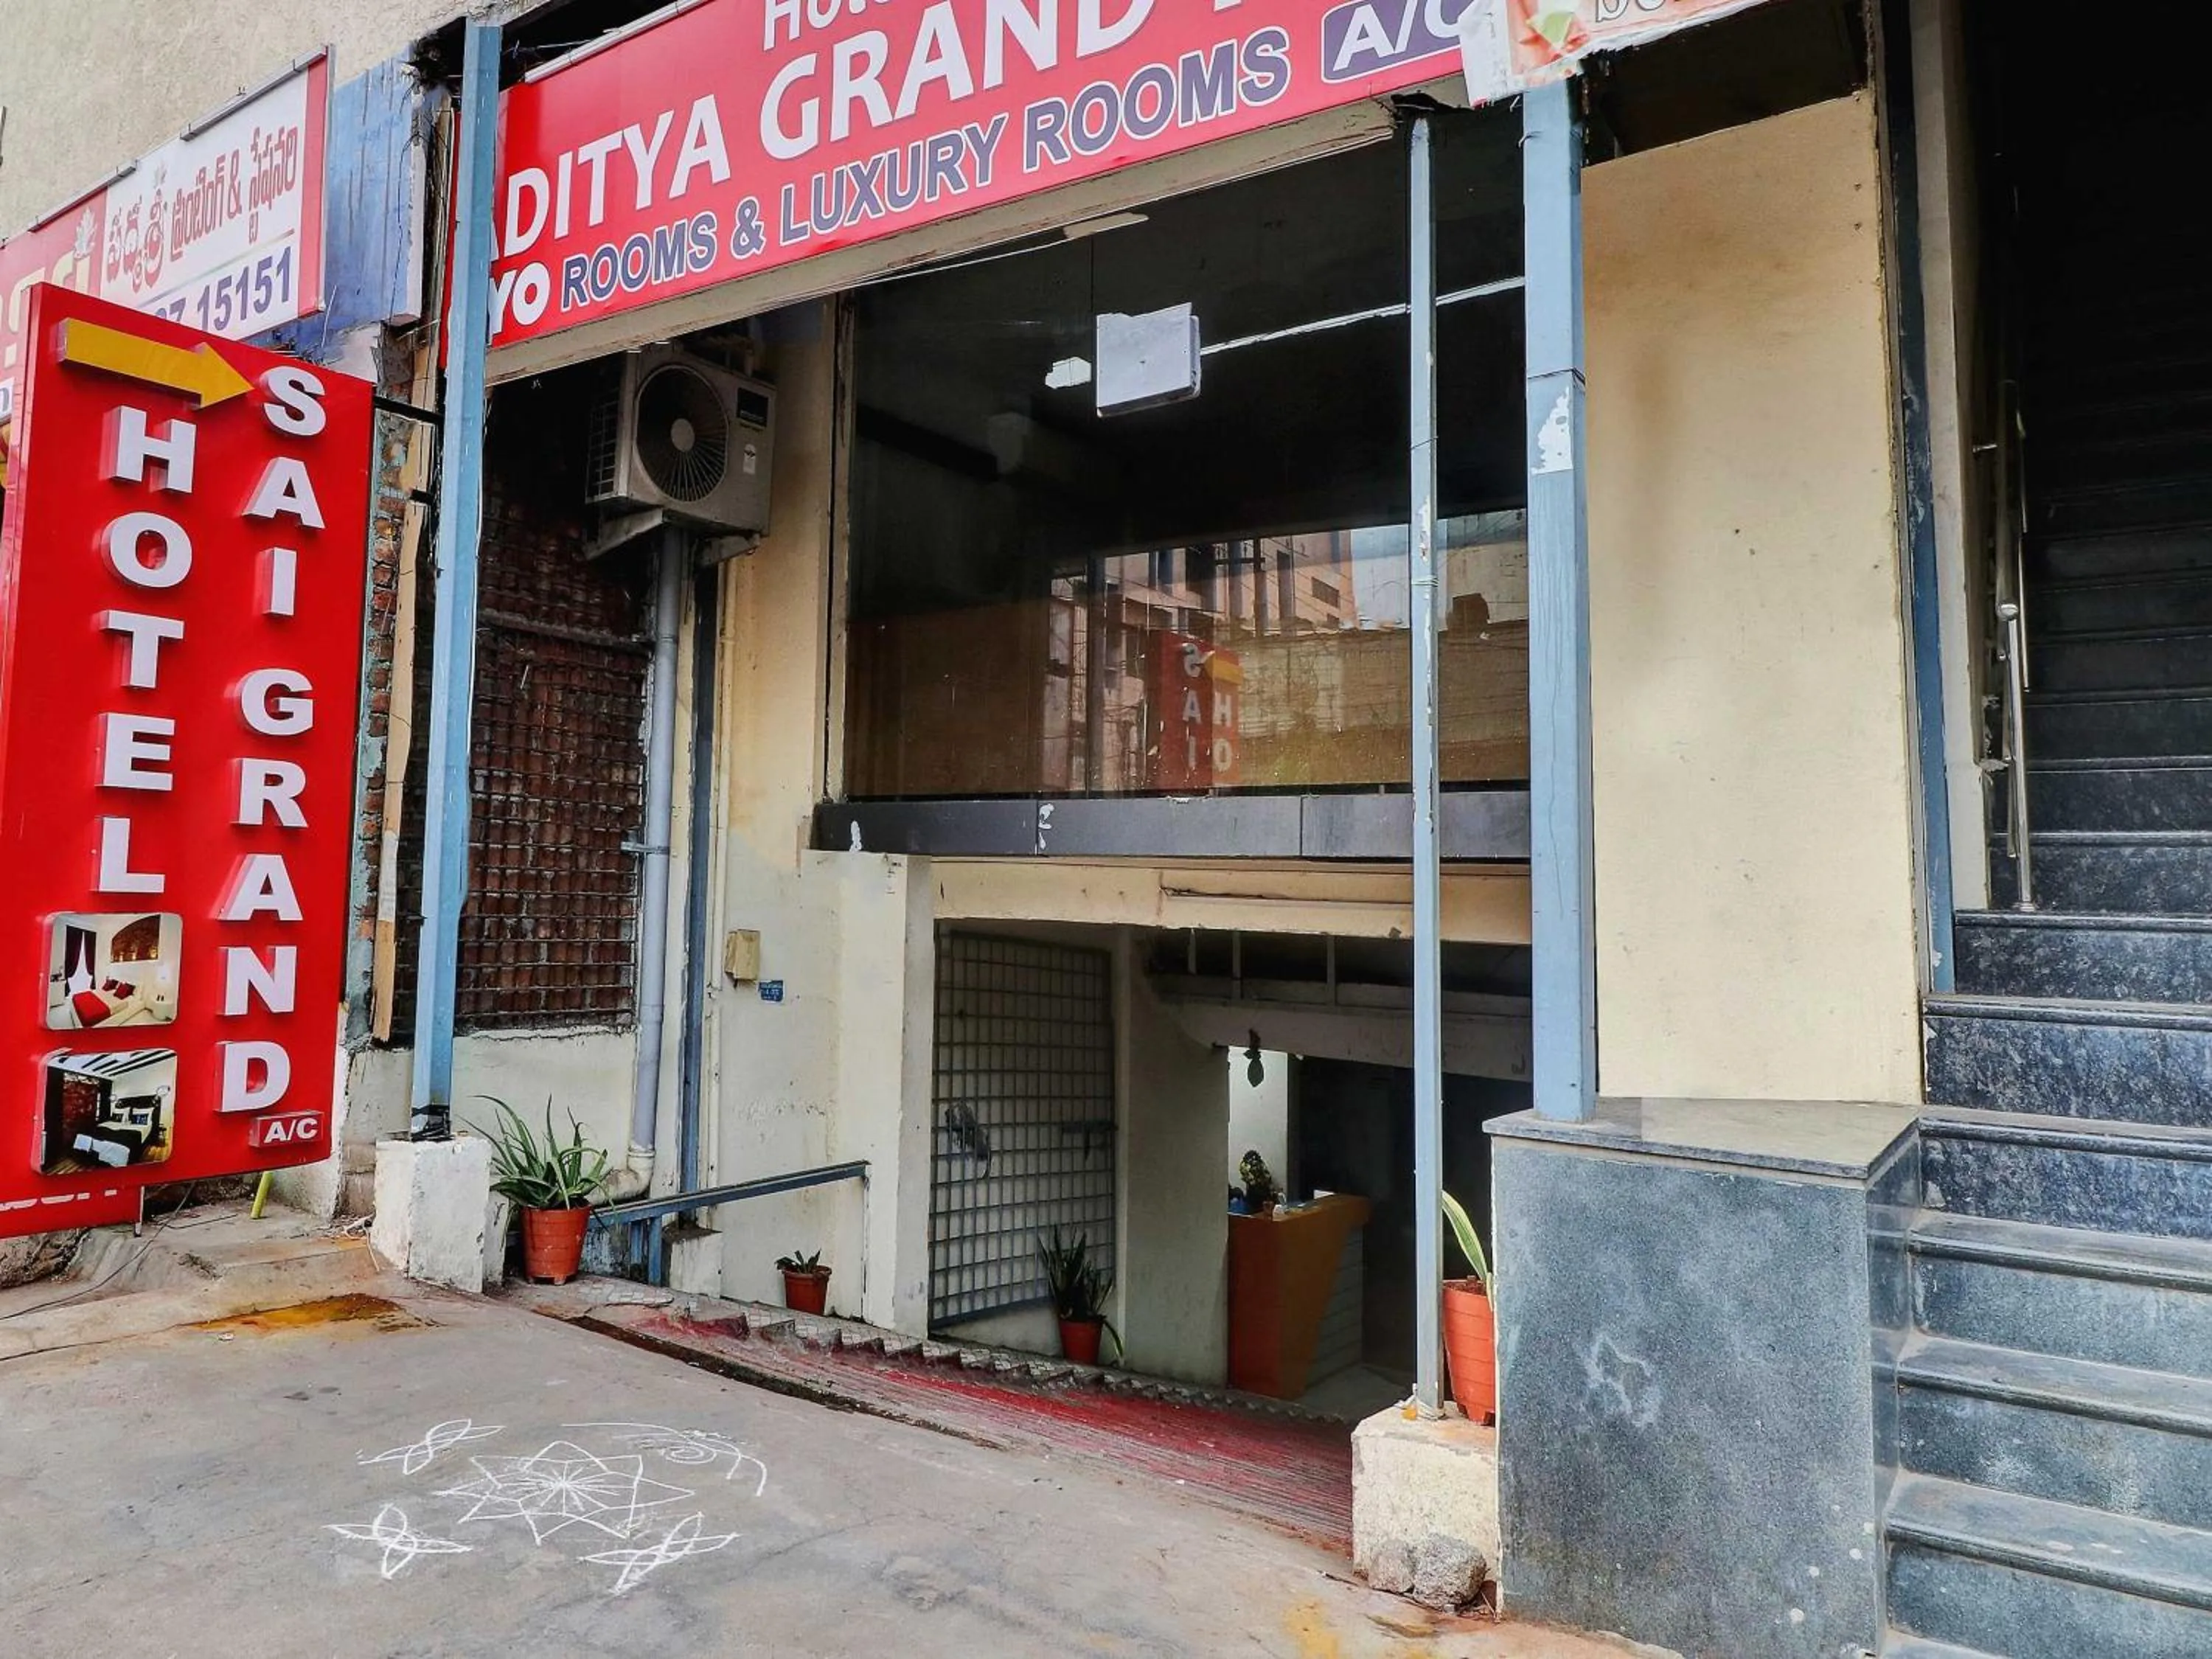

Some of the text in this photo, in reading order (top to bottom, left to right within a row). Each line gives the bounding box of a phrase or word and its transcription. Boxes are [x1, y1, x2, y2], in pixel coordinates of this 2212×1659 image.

[227, 149, 242, 219] &
[487, 26, 1292, 333] YO ROOMS & LUXURY ROOMS
[491, 0, 1161, 262] DITYA GRAND
[197, 246, 291, 332] 15151
[98, 404, 197, 894] HOTEL
[220, 365, 327, 1111] SAI GRAND
[264, 1116, 319, 1144] A/C
